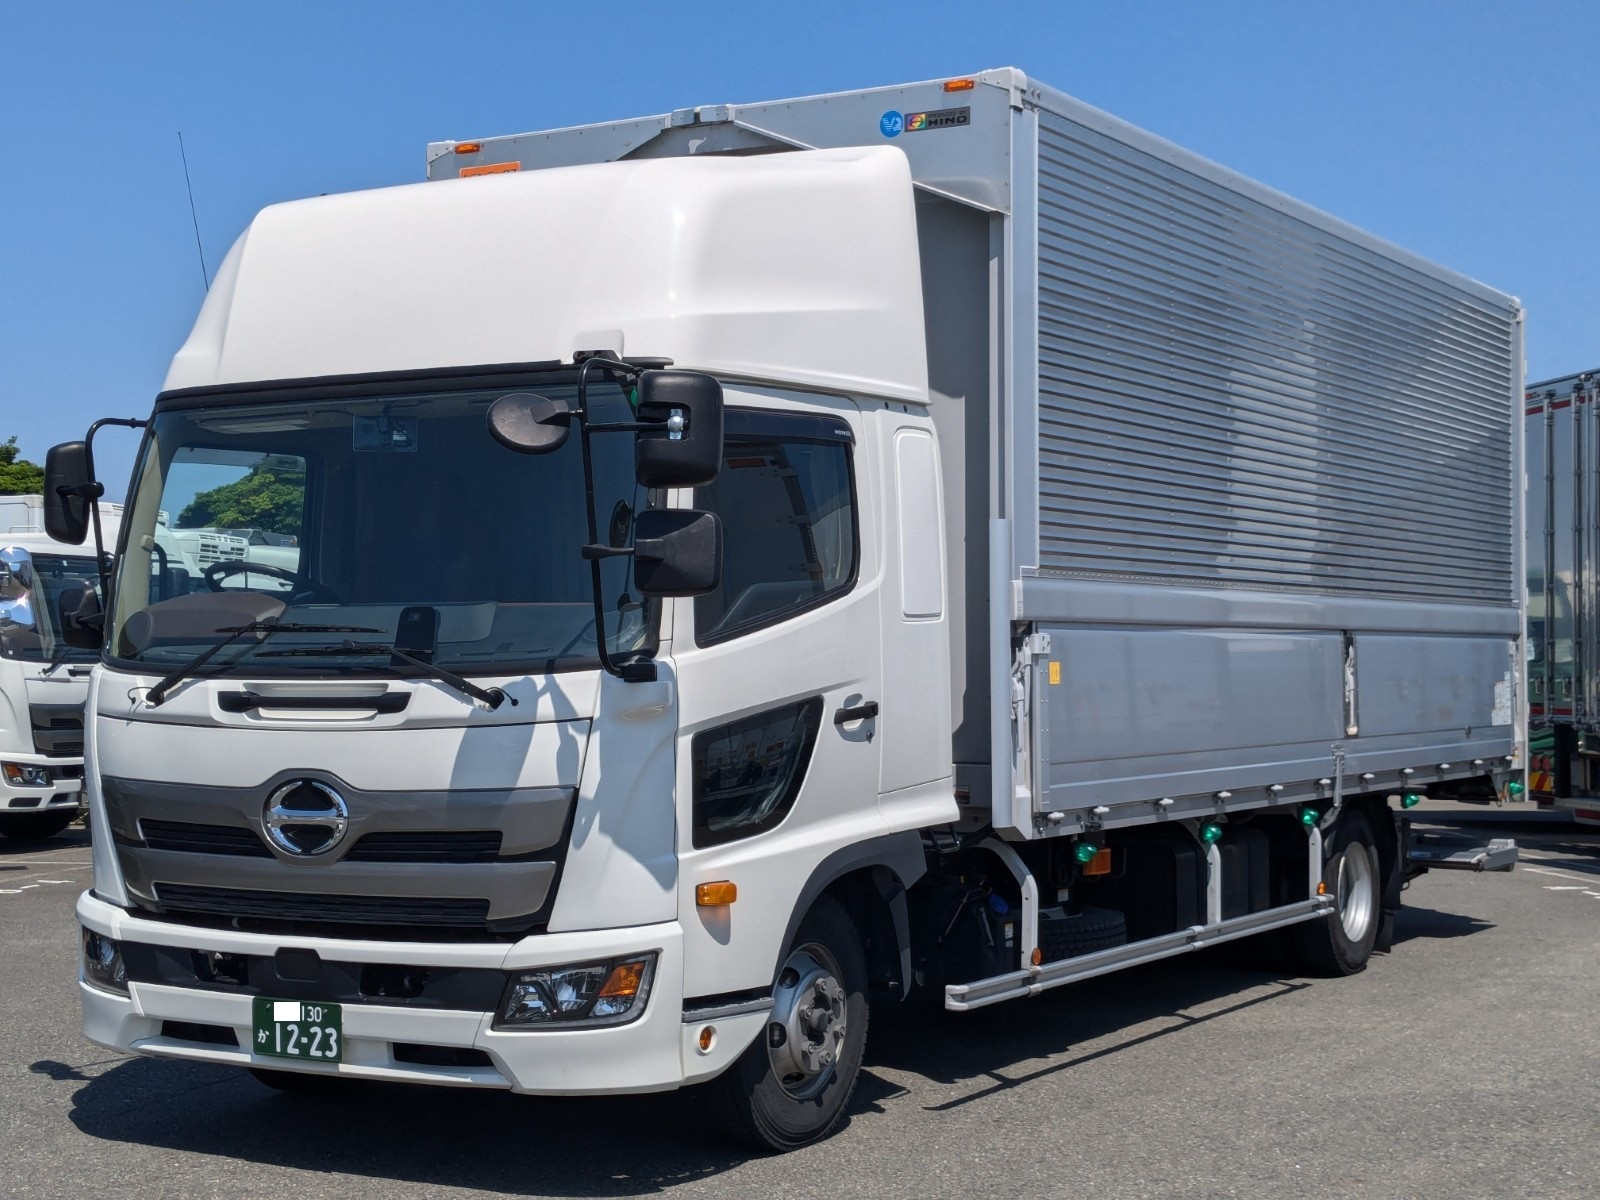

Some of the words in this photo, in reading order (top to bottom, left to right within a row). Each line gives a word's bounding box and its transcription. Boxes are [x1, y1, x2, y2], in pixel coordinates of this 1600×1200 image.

[928, 115, 967, 127] HINO
[301, 1005, 322, 1022] 130
[258, 1029, 269, 1043] か
[276, 1022, 338, 1057] 12-23
